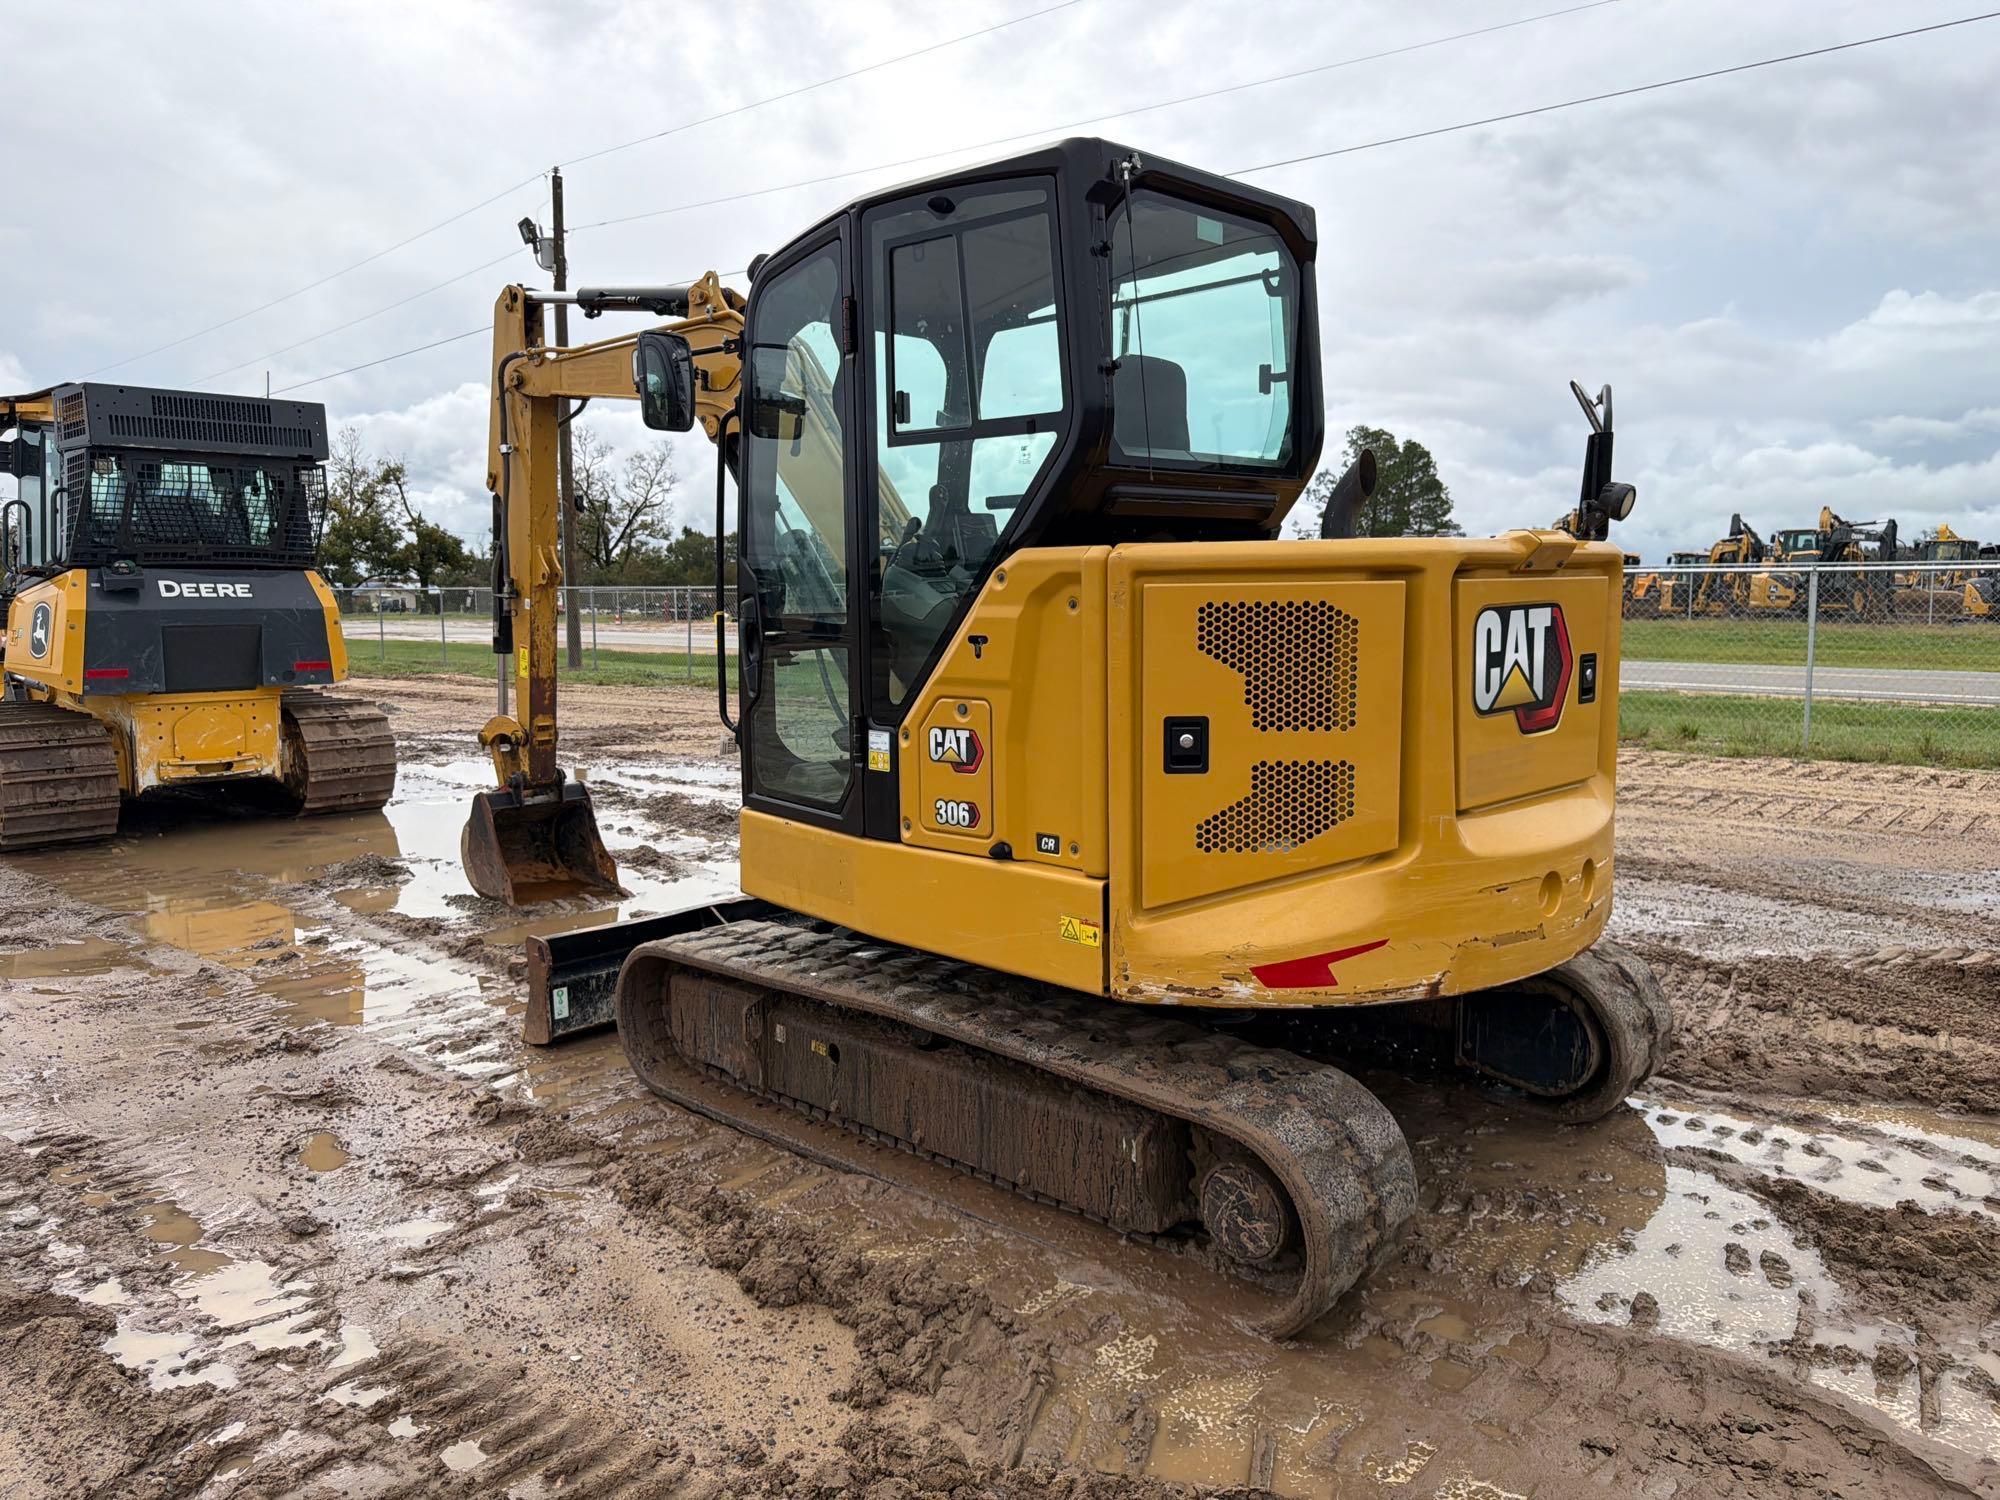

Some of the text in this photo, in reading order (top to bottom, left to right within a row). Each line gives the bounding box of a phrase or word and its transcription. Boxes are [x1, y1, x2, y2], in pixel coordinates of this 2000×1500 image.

[158, 580, 253, 598] DEERE
[1475, 607, 1552, 710] CAT
[930, 727, 970, 762] CAT
[936, 801, 970, 826] 306
[1042, 837, 1055, 850] CR
